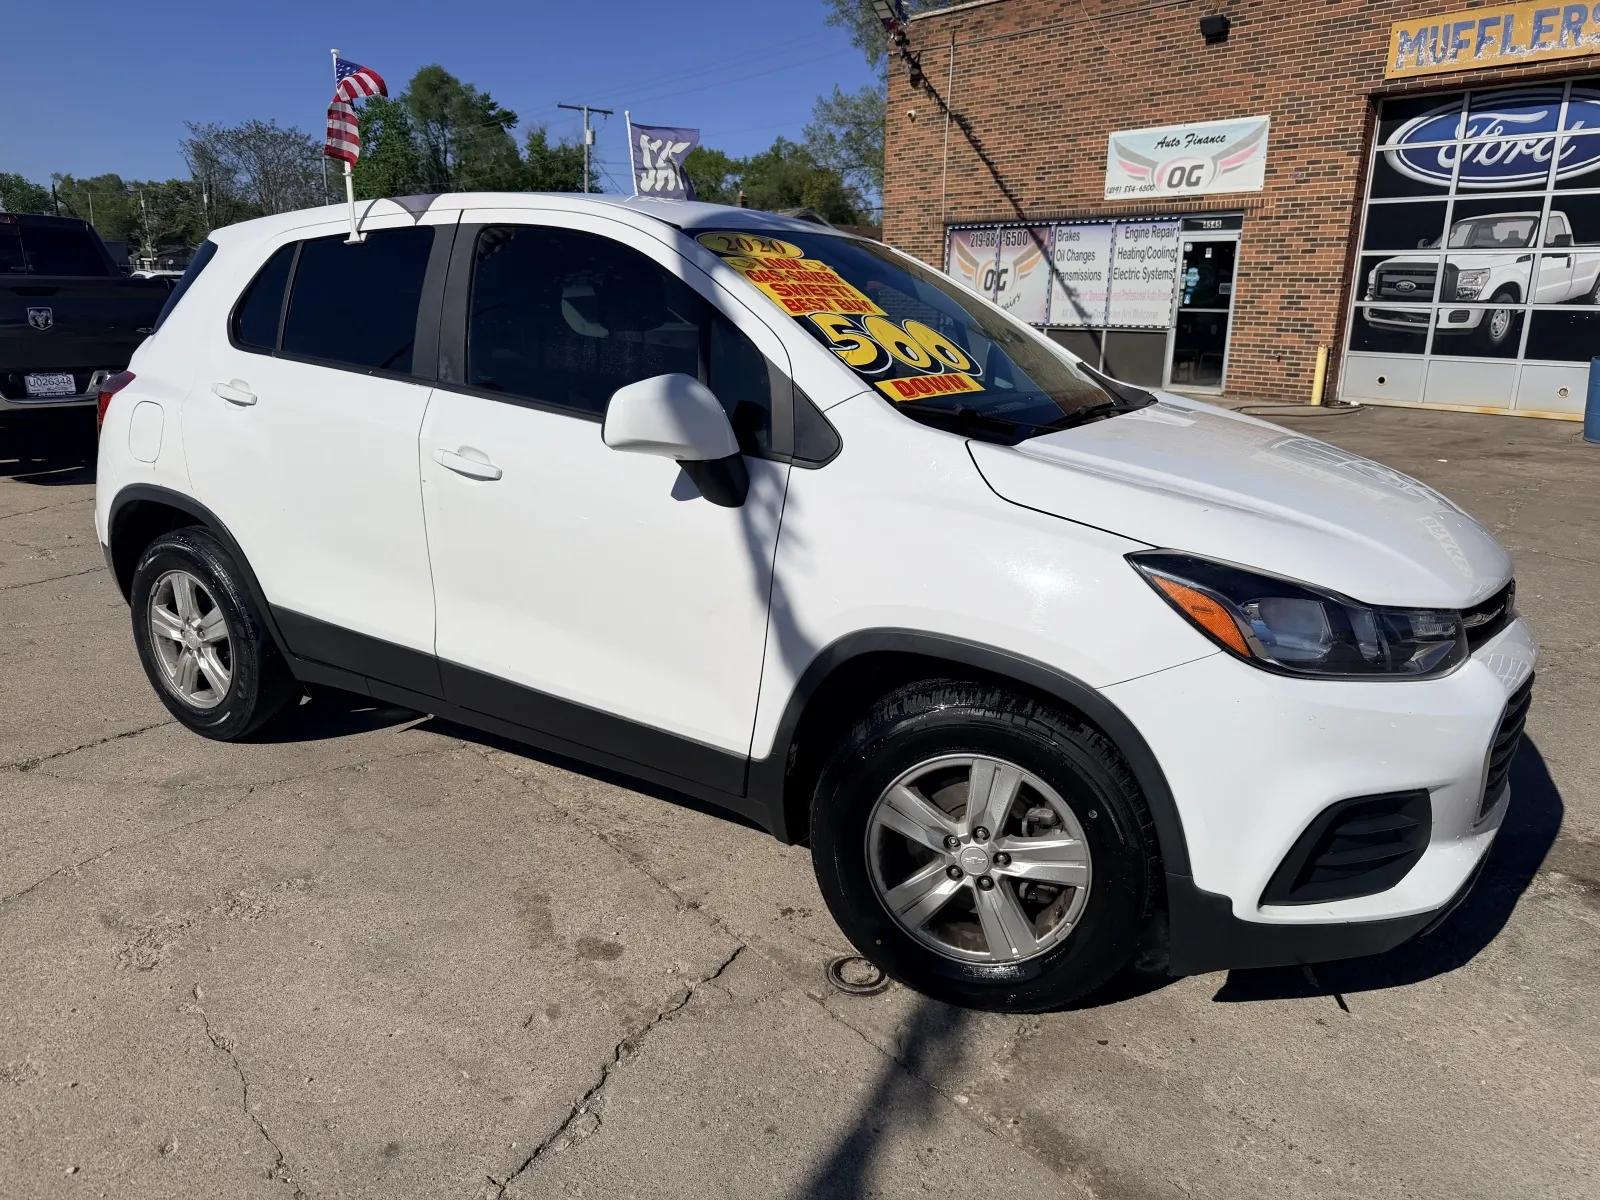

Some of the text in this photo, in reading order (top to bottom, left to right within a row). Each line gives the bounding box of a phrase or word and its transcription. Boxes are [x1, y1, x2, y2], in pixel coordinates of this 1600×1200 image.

[1154, 133, 1226, 149] Auto Finance
[1437, 110, 1584, 168] Ford
[1167, 164, 1205, 188] OG
[970, 230, 1028, 247] 219-88-6500
[1057, 230, 1080, 242] Brakes
[1125, 225, 1176, 242] Engine Repair
[717, 236, 787, 254] 2020
[1056, 248, 1096, 264] Oil Changes
[1117, 246, 1175, 263] Heating/Cooling
[752, 257, 807, 270] LOOK
[1113, 266, 1173, 283] Electric Systems
[781, 298, 874, 313] BEST BUY
[807, 312, 983, 376] 500
[890, 374, 973, 399] DOWN
